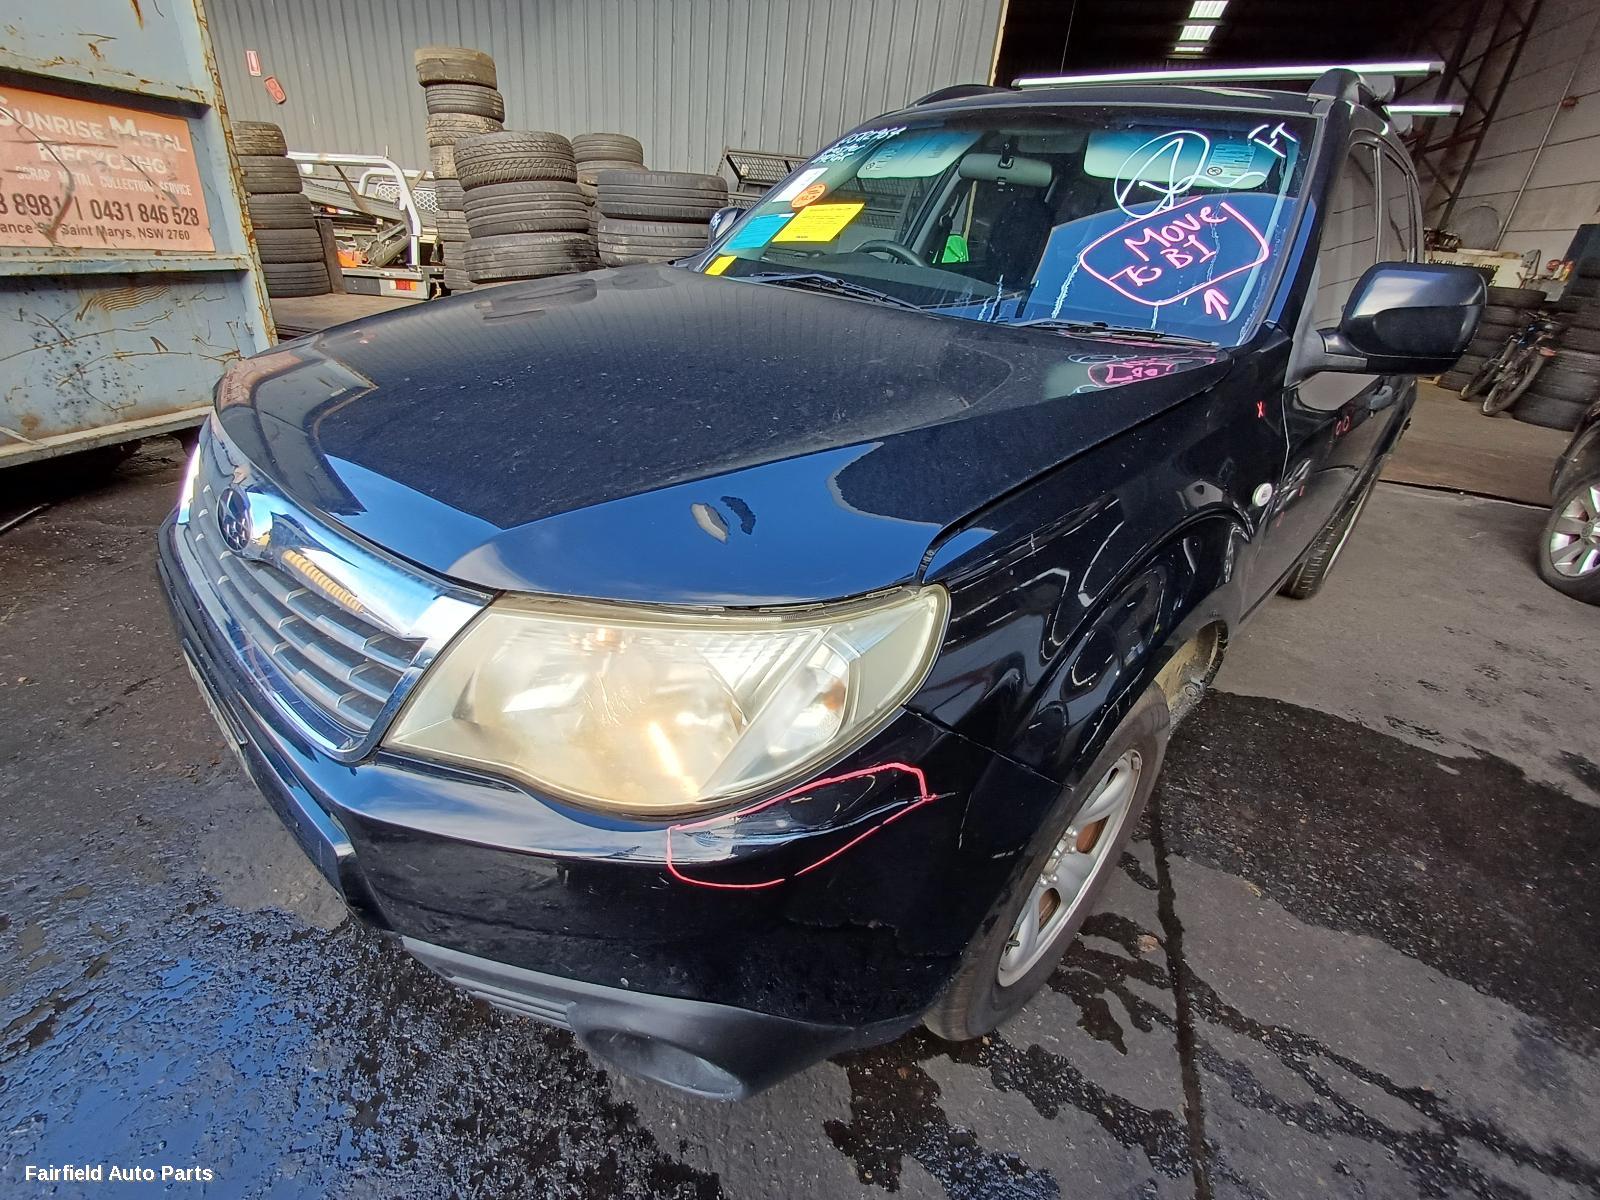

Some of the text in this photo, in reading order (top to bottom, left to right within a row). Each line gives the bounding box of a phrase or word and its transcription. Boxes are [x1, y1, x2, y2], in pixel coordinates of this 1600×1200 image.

[90, 199, 134, 222] 0431
[138, 203, 169, 225] 846
[172, 207, 200, 226] 528
[60, 223, 94, 237] Saint
[137, 227, 164, 239] NSW
[166, 229, 190, 241] 2760
